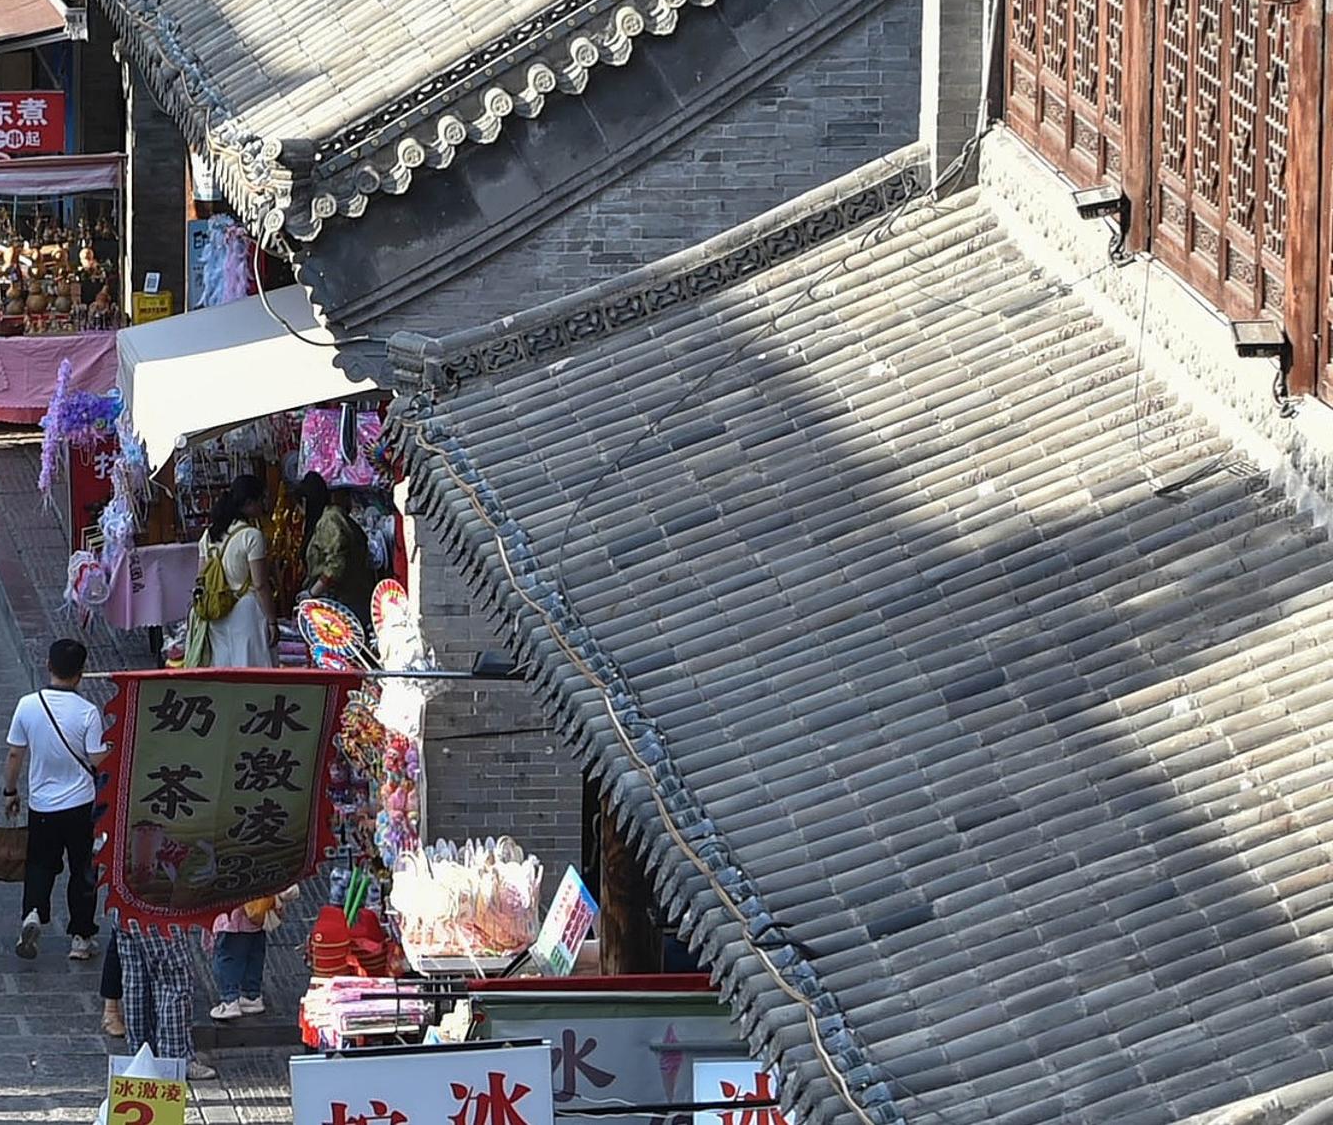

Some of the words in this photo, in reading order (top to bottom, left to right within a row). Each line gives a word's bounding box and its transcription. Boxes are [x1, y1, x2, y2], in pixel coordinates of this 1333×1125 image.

[139, 688, 216, 820] 奶茶
[227, 695, 310, 845] 冰激凌
[114, 1080, 182, 1102] 冰激凌
